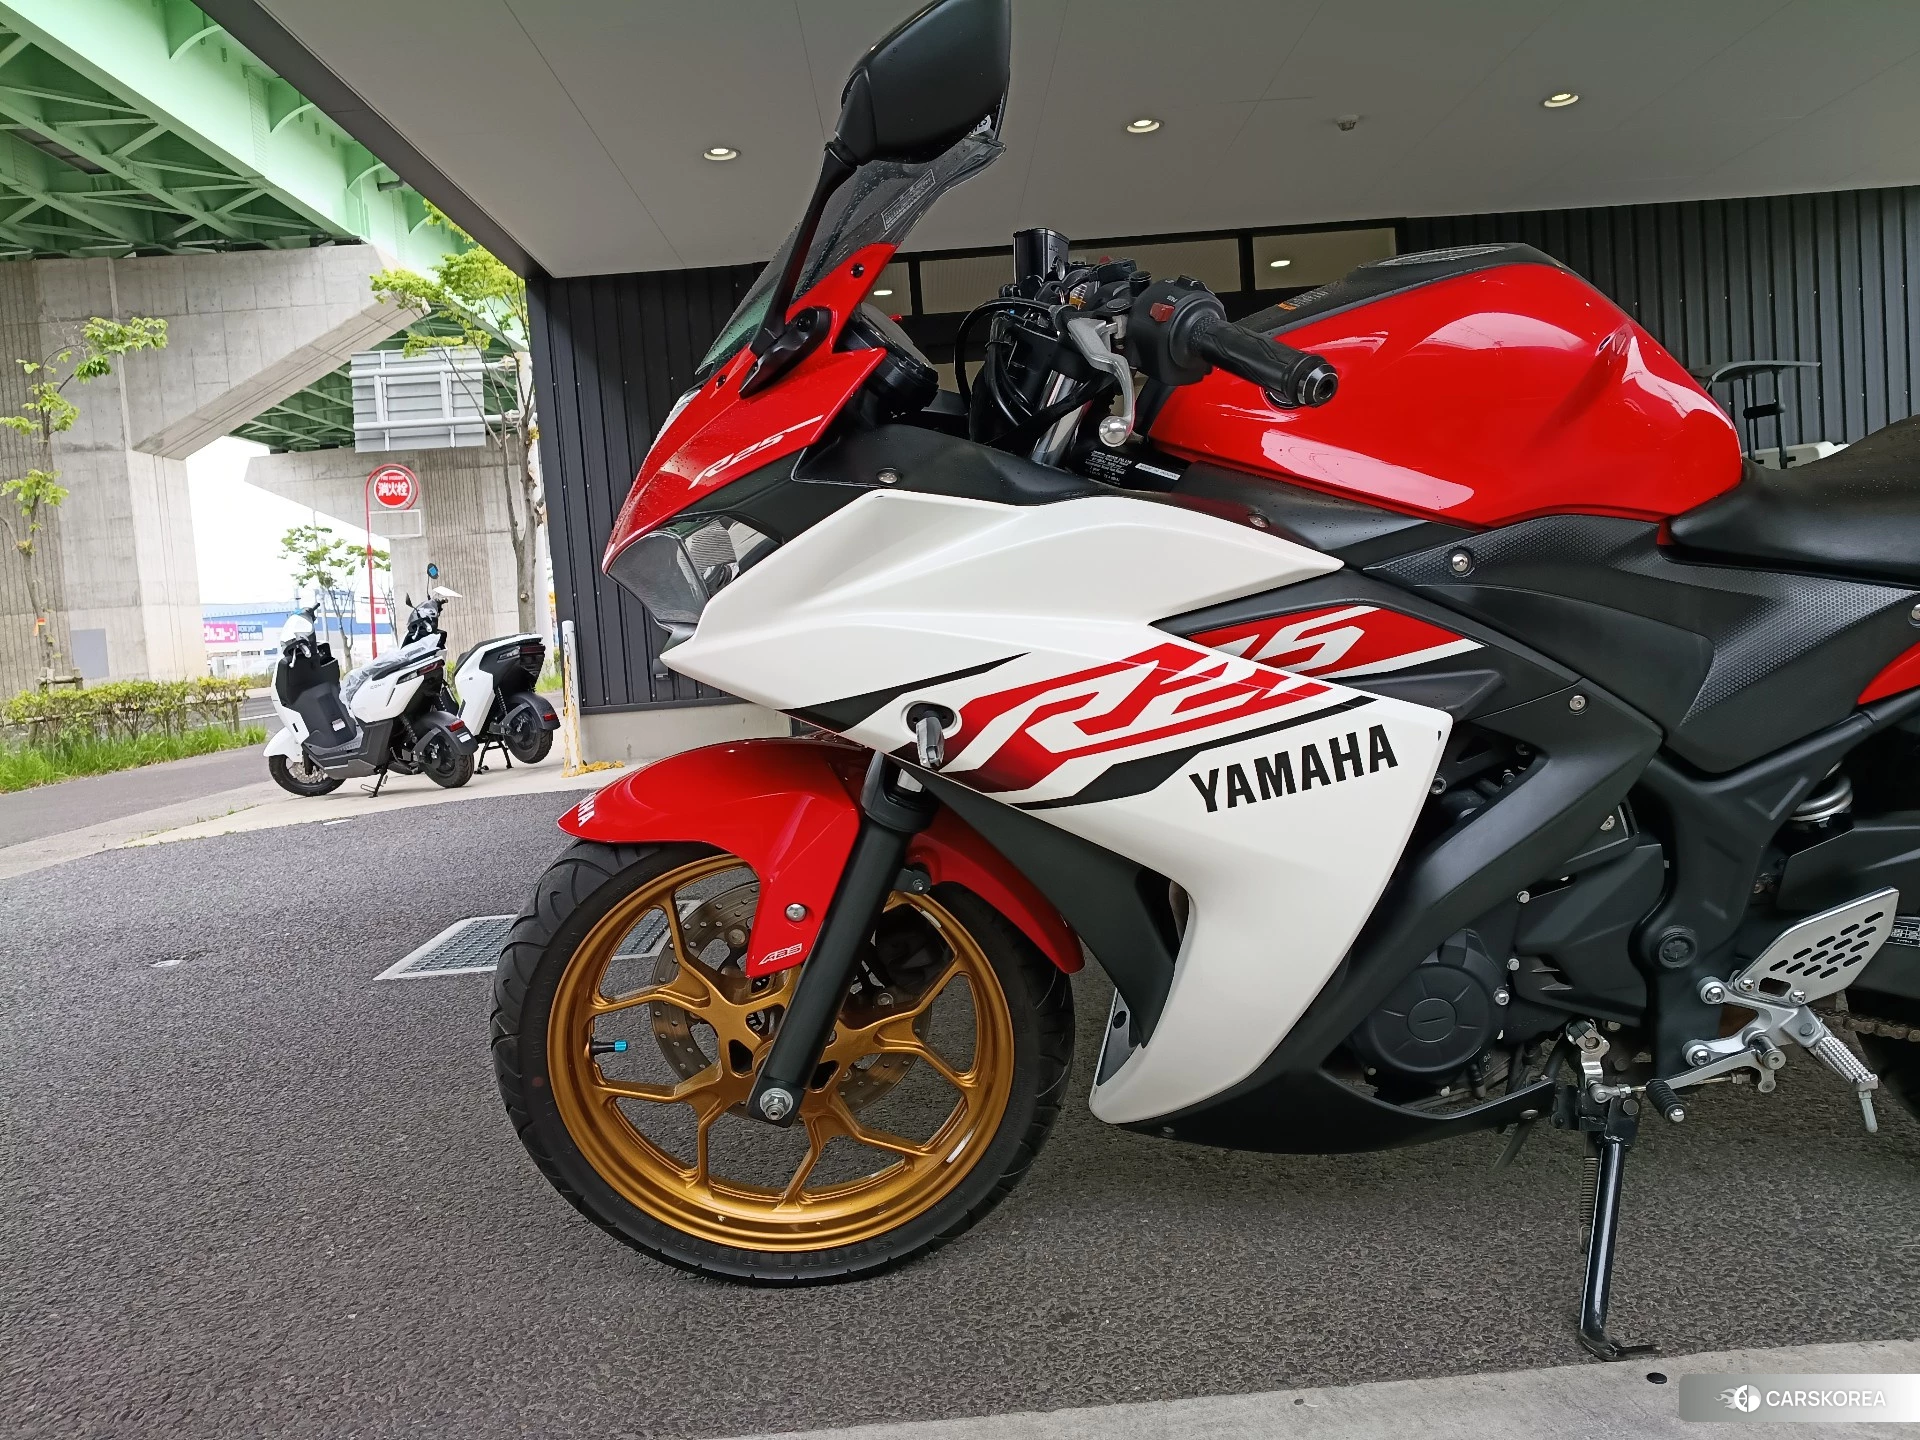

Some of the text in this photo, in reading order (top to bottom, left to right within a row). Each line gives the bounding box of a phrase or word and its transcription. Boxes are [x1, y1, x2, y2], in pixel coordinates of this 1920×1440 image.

[688, 415, 824, 490] R25
[378, 482, 408, 496] 消火栓
[1188, 723, 1398, 813] YAMAHA
[758, 943, 803, 966] ABS
